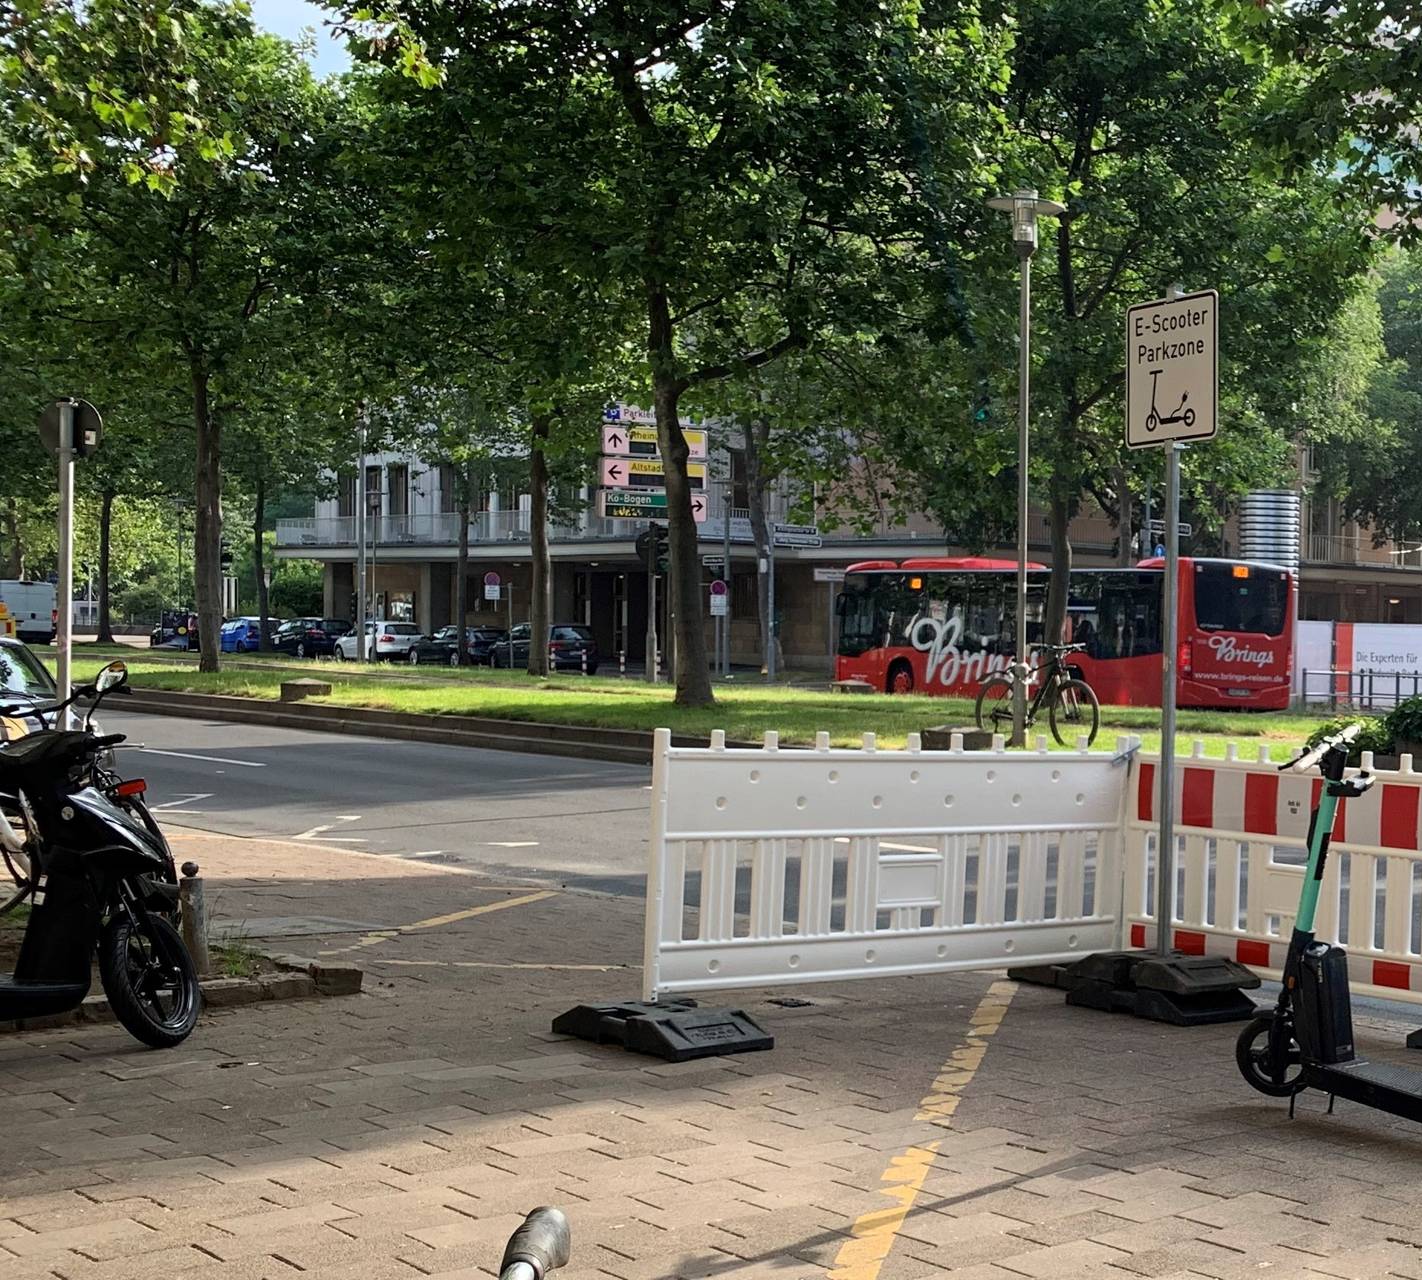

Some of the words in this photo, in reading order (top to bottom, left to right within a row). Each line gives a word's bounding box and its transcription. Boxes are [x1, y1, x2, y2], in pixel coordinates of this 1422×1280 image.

[1135, 309, 1208, 337] E-Scooter
[1138, 340, 1204, 364] Parkzone
[911, 616, 1039, 686] Brins
[1208, 636, 1274, 668] Brings
[1356, 652, 1368, 662] Die
[1370, 653, 1404, 664] Experten
